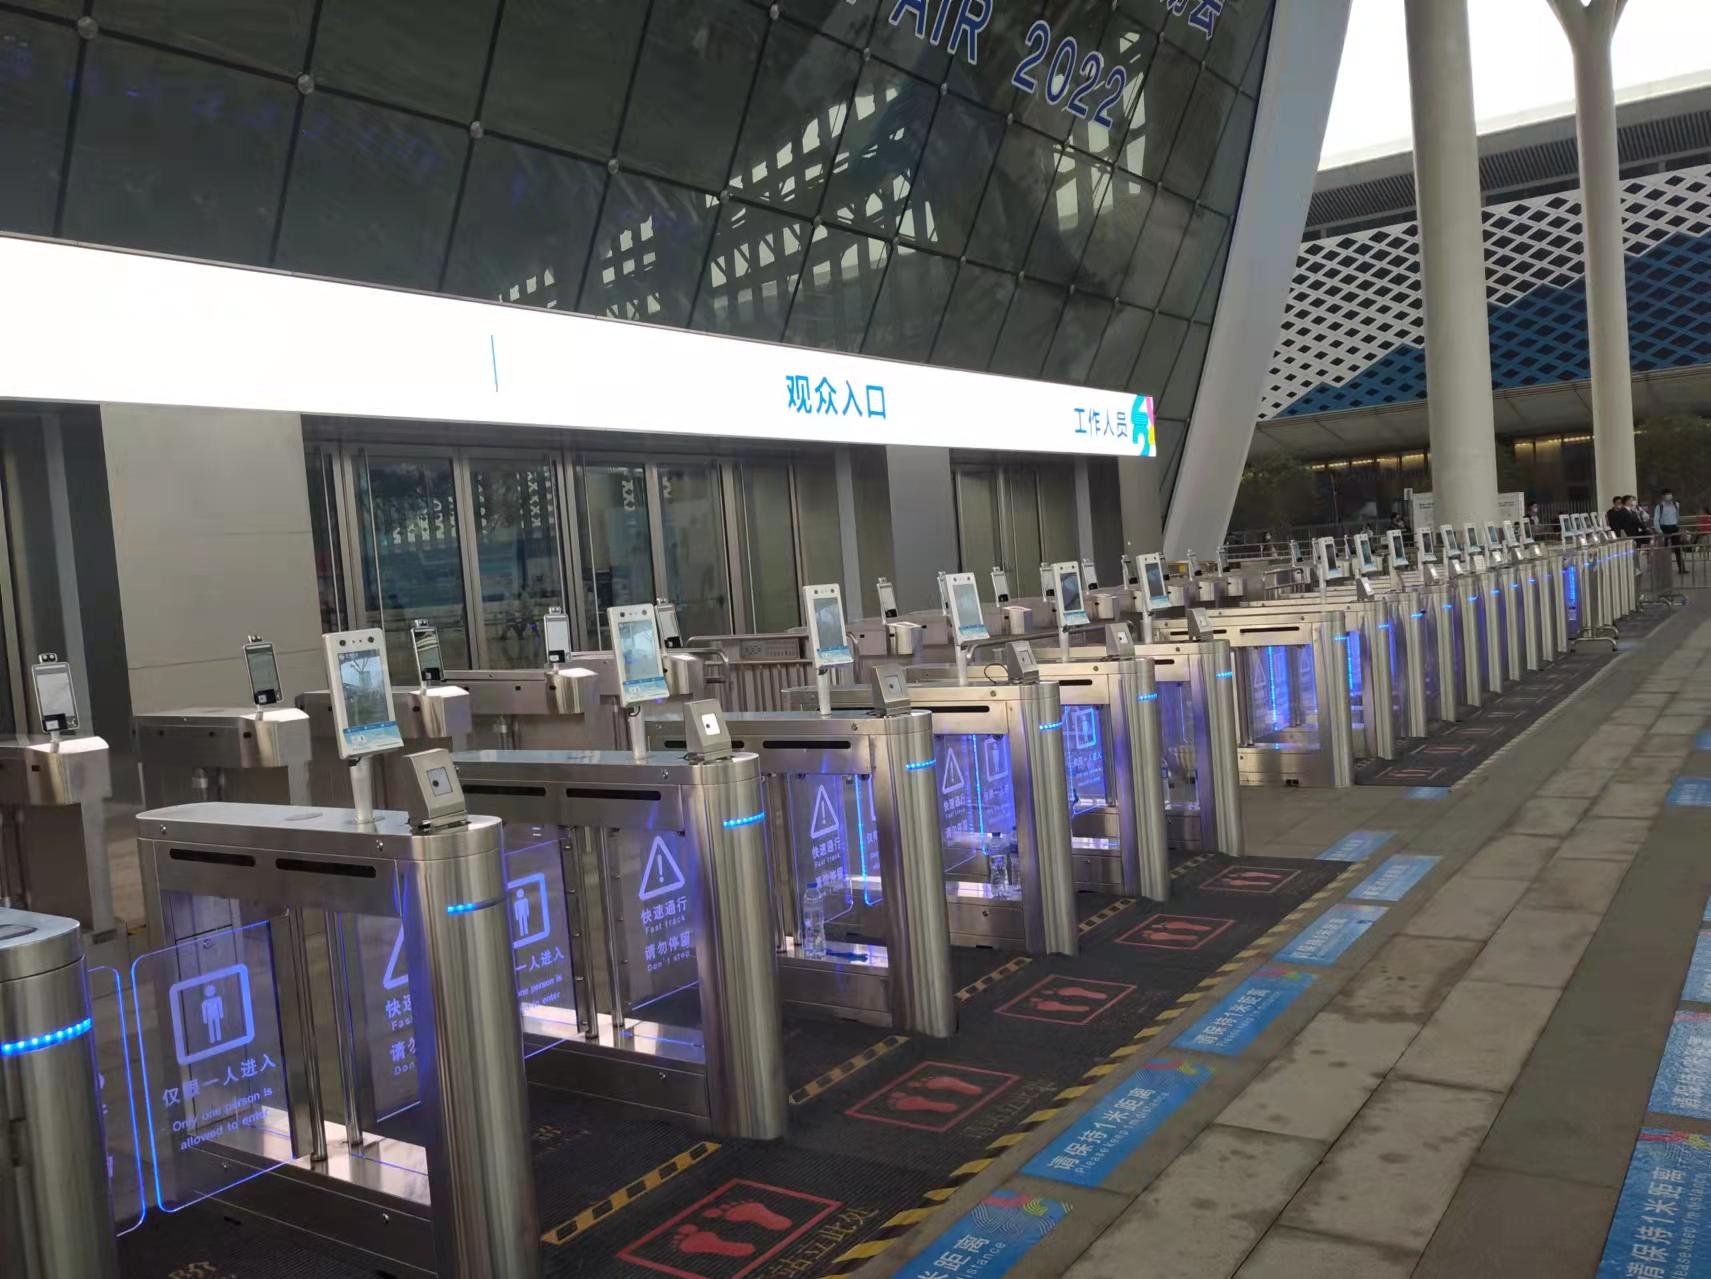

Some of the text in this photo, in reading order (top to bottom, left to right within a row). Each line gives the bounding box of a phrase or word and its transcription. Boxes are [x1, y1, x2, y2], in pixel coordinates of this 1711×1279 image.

[1012, 19, 1127, 129] 2022
[785, 374, 887, 420] 观众入口
[1073, 407, 1128, 438] 工作人员
[640, 895, 687, 925] 快速通行
[645, 922, 662, 937] Fast
[644, 930, 691, 961] 请勿停留
[162, 1053, 277, 1109] 仅限一人进入
[172, 1087, 273, 1133] Only one person is
[179, 1109, 268, 1152] allowed to enter
[1046, 1086, 1157, 1170] 请保持1米距离
